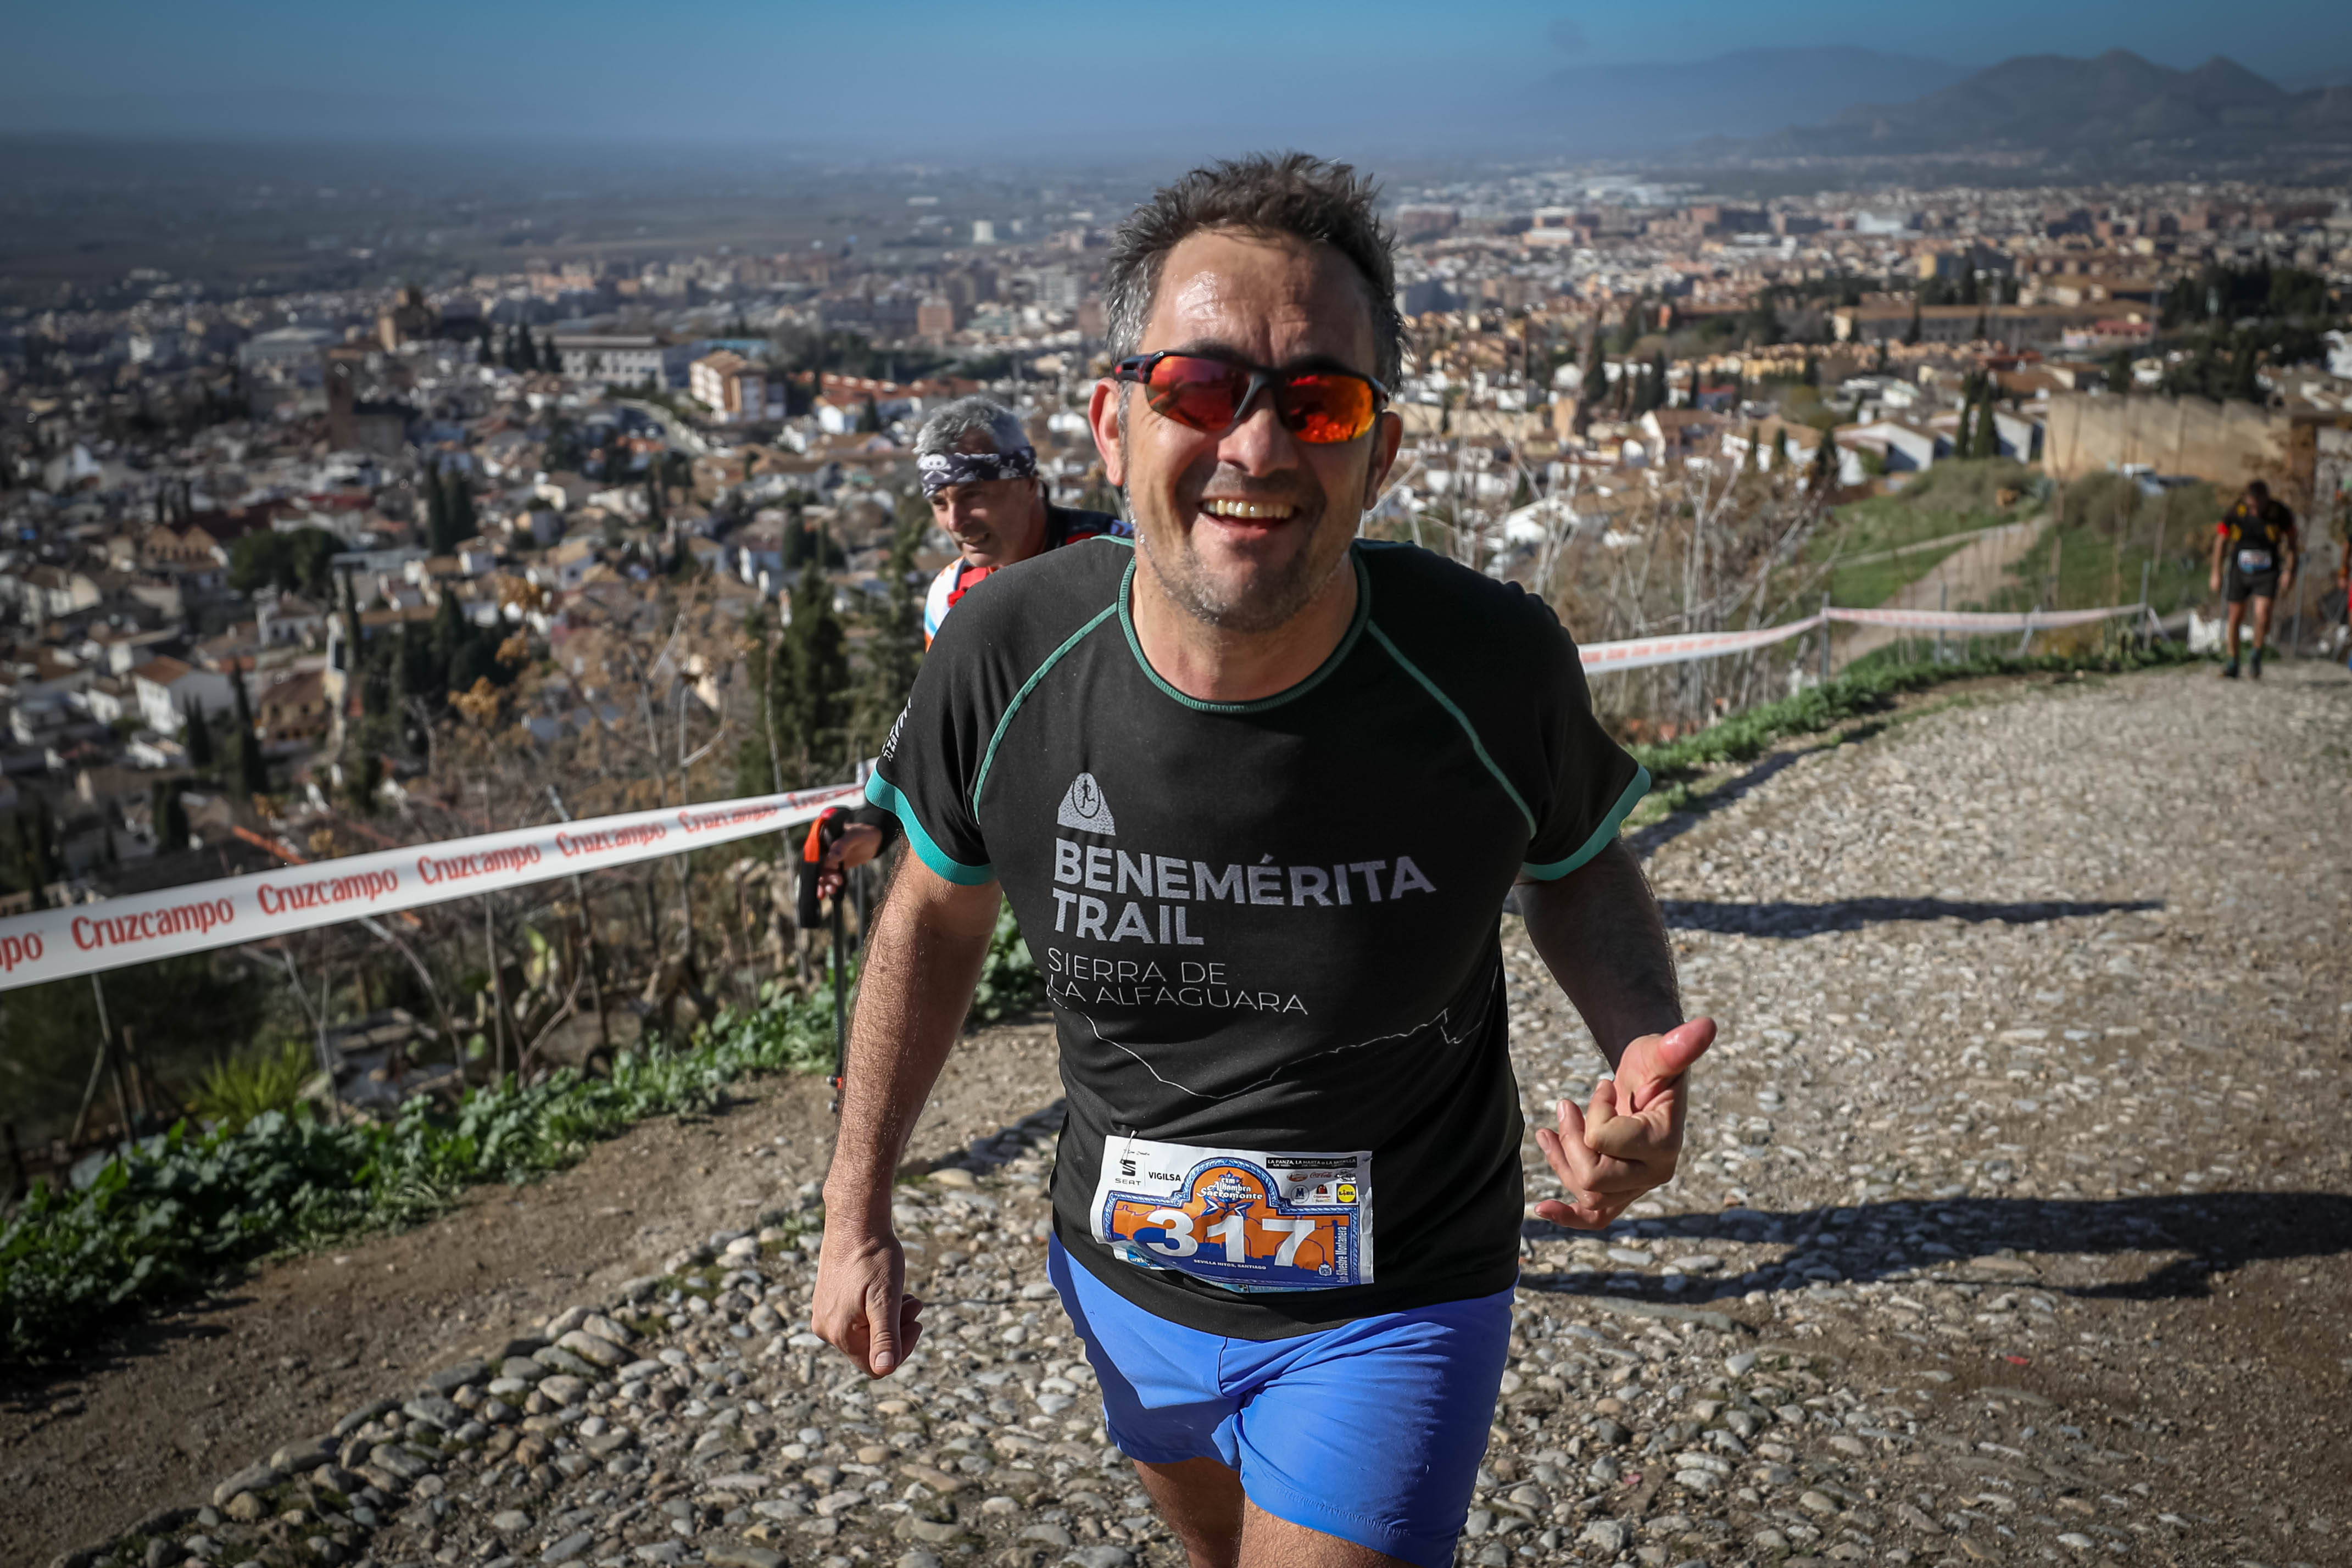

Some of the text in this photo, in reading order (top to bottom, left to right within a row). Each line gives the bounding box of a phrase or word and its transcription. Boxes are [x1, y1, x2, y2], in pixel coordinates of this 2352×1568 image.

[71, 898, 235, 951] Cruzcampo
[258, 868, 398, 916] Cruzcampo
[417, 842, 540, 885] Cruzcampo
[555, 820, 666, 857] Cruzcampo
[678, 802, 778, 833] Cruzcampo
[1054, 836, 1436, 907] BENEMÉRITA
[1051, 888, 1205, 945] TRAIL
[1047, 947, 1227, 985] SIERRA DE
[1050, 974, 1308, 1015] LA ALFAGUARA
[1149, 1171, 1181, 1181] VIGILSA
[1196, 1187, 1263, 1200] Sacromonte
[1207, 1181, 1251, 1192] Alhambra
[1146, 1209, 1316, 1267] 317
[1335, 1226, 1347, 1255] Montañera
[1335, 1256, 1348, 1276] Silvestre
